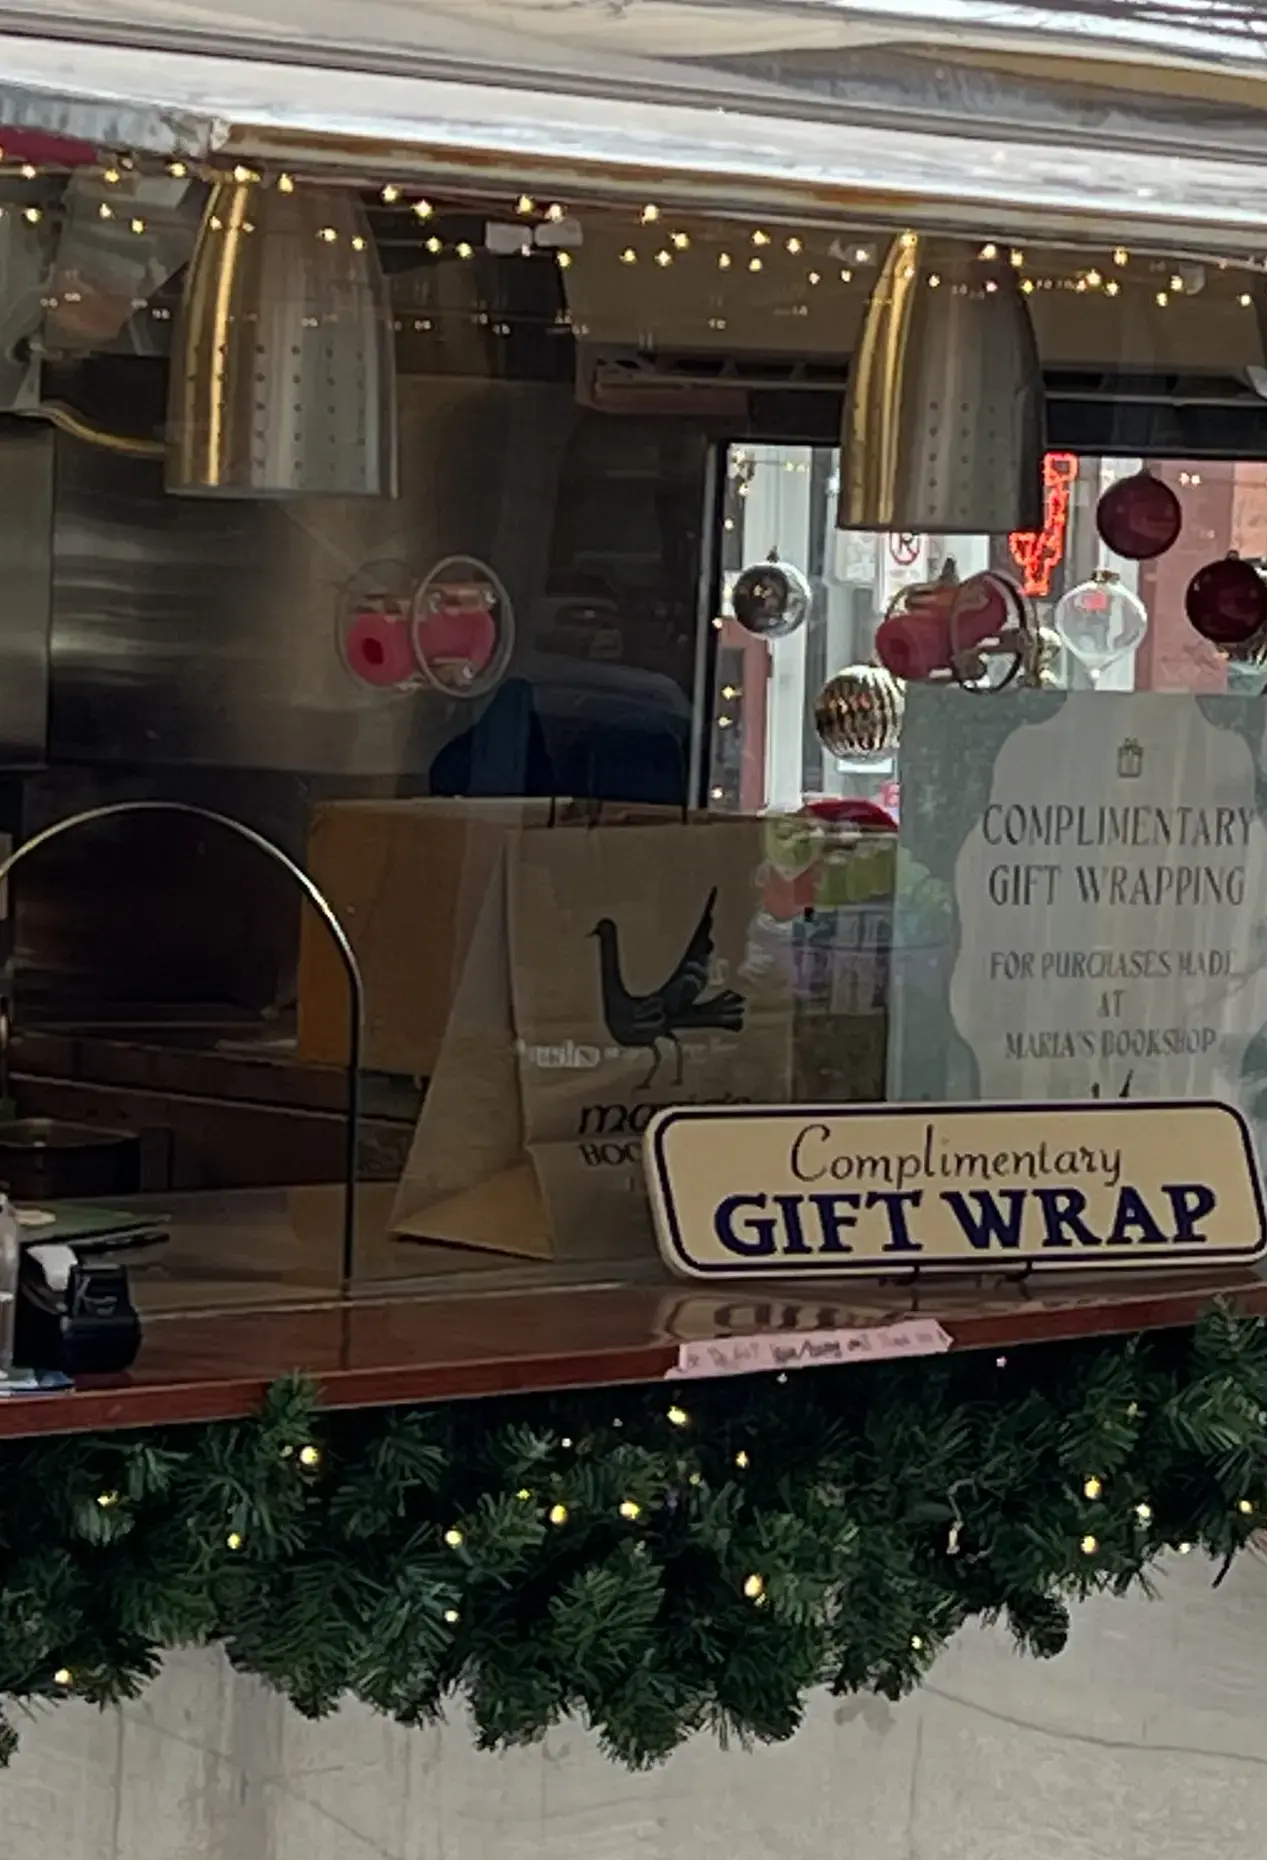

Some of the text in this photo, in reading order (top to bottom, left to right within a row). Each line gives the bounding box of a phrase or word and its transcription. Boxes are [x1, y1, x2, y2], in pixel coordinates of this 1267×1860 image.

[982, 803, 1254, 847] COMPLIMENTARY
[989, 864, 1246, 906] GIFT WRAPPING
[990, 951, 1035, 980] FOR
[1041, 949, 1172, 979] PURCHASES
[1097, 989, 1126, 1018] AT
[1005, 1027, 1217, 1060] MARIA'S BOOKSHOP
[790, 1125, 1122, 1187] Complimentary
[714, 1185, 1217, 1256] GIFT WRAP
